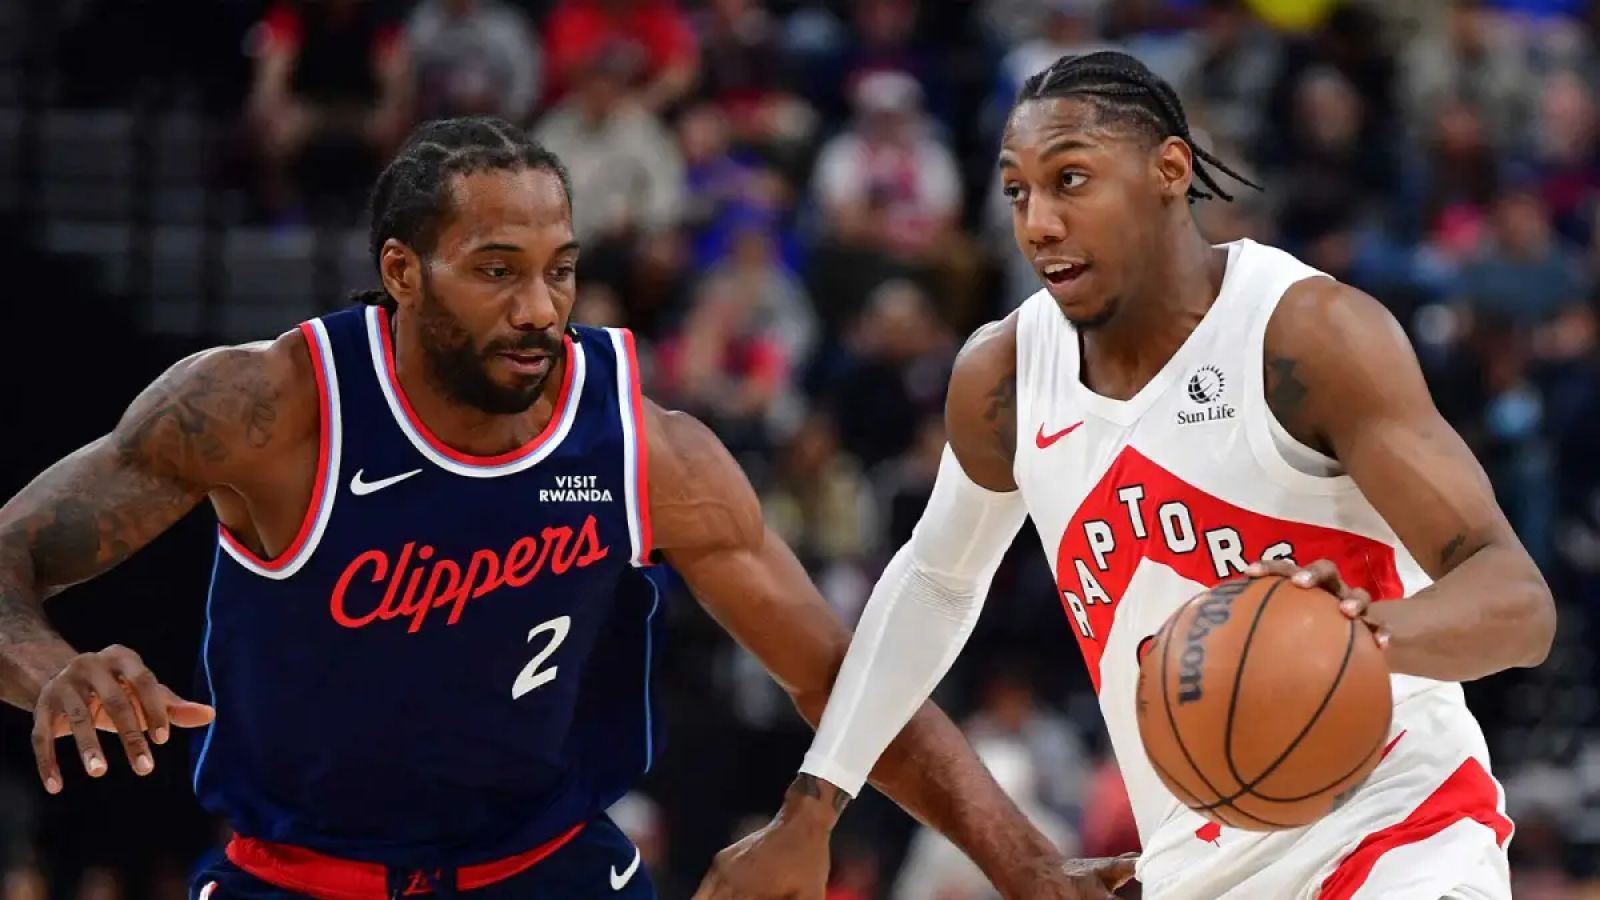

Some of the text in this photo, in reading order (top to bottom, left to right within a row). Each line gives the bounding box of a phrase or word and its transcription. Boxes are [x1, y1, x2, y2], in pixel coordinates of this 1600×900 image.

[1177, 403, 1236, 424] Sun Life
[554, 475, 598, 489] VISIT
[539, 489, 613, 502] RWANDA
[330, 513, 610, 633] Clippers
[511, 615, 572, 700] 2
